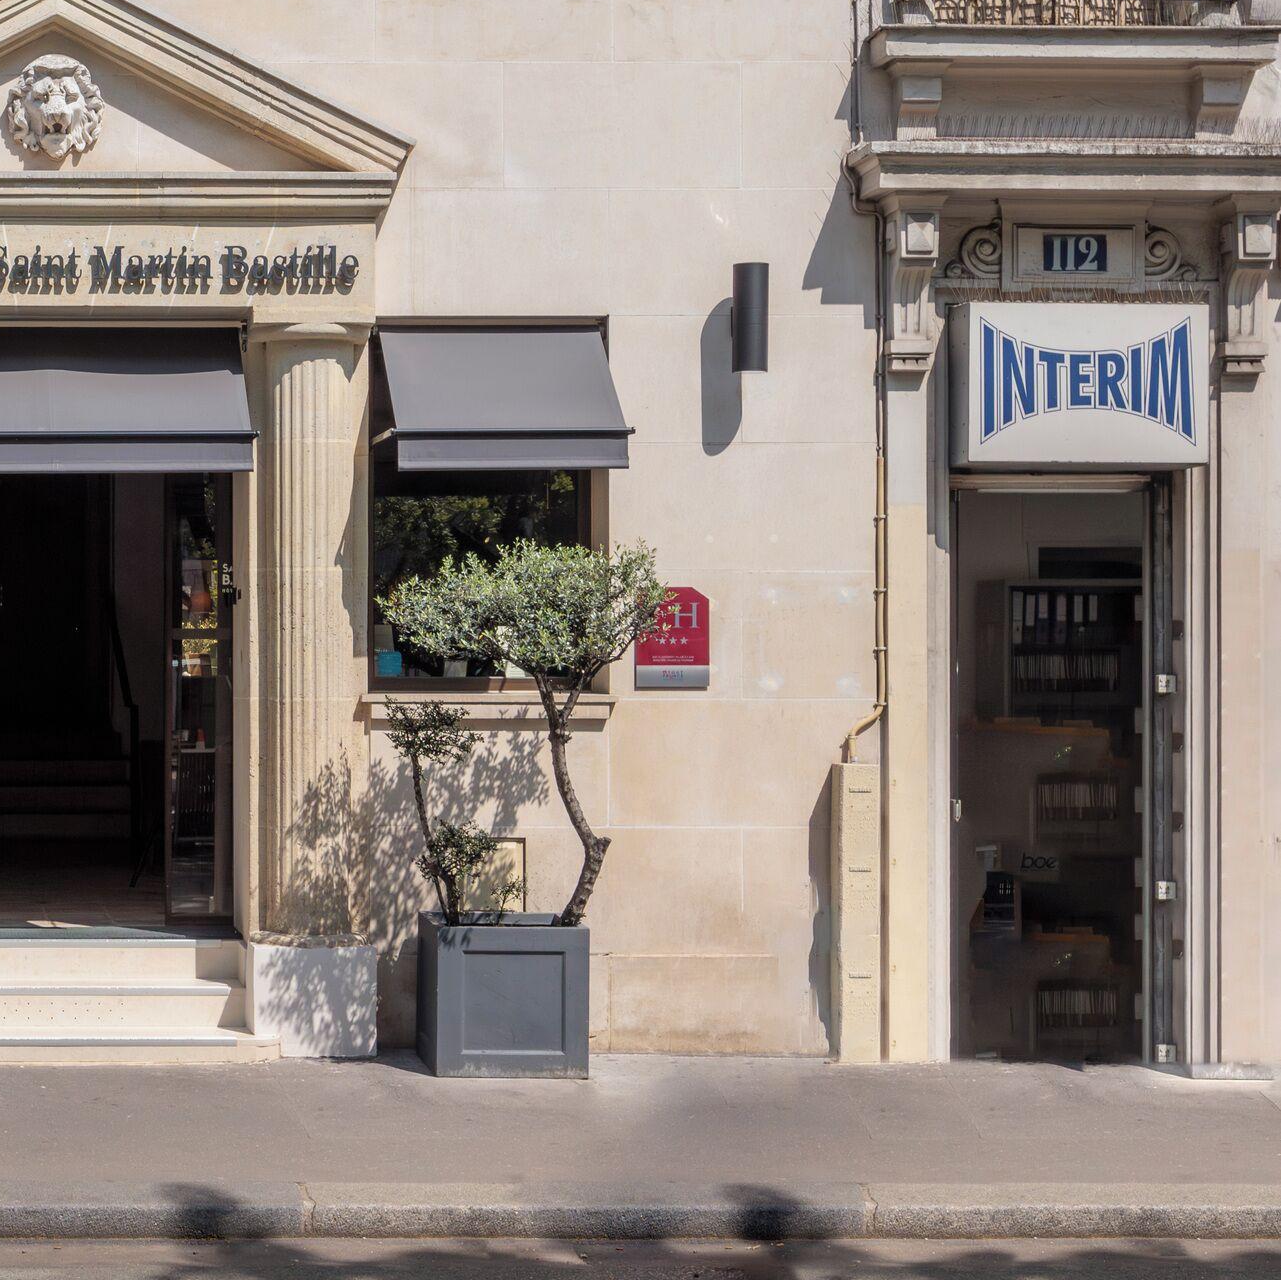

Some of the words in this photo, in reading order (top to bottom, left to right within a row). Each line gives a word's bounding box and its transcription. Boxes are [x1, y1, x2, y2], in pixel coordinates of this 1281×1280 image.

[92, 245, 214, 281] Martin
[223, 244, 360, 281] Bastille
[1051, 236, 1099, 272] 112
[979, 315, 1197, 446] INTERIM
[672, 601, 700, 629] H
